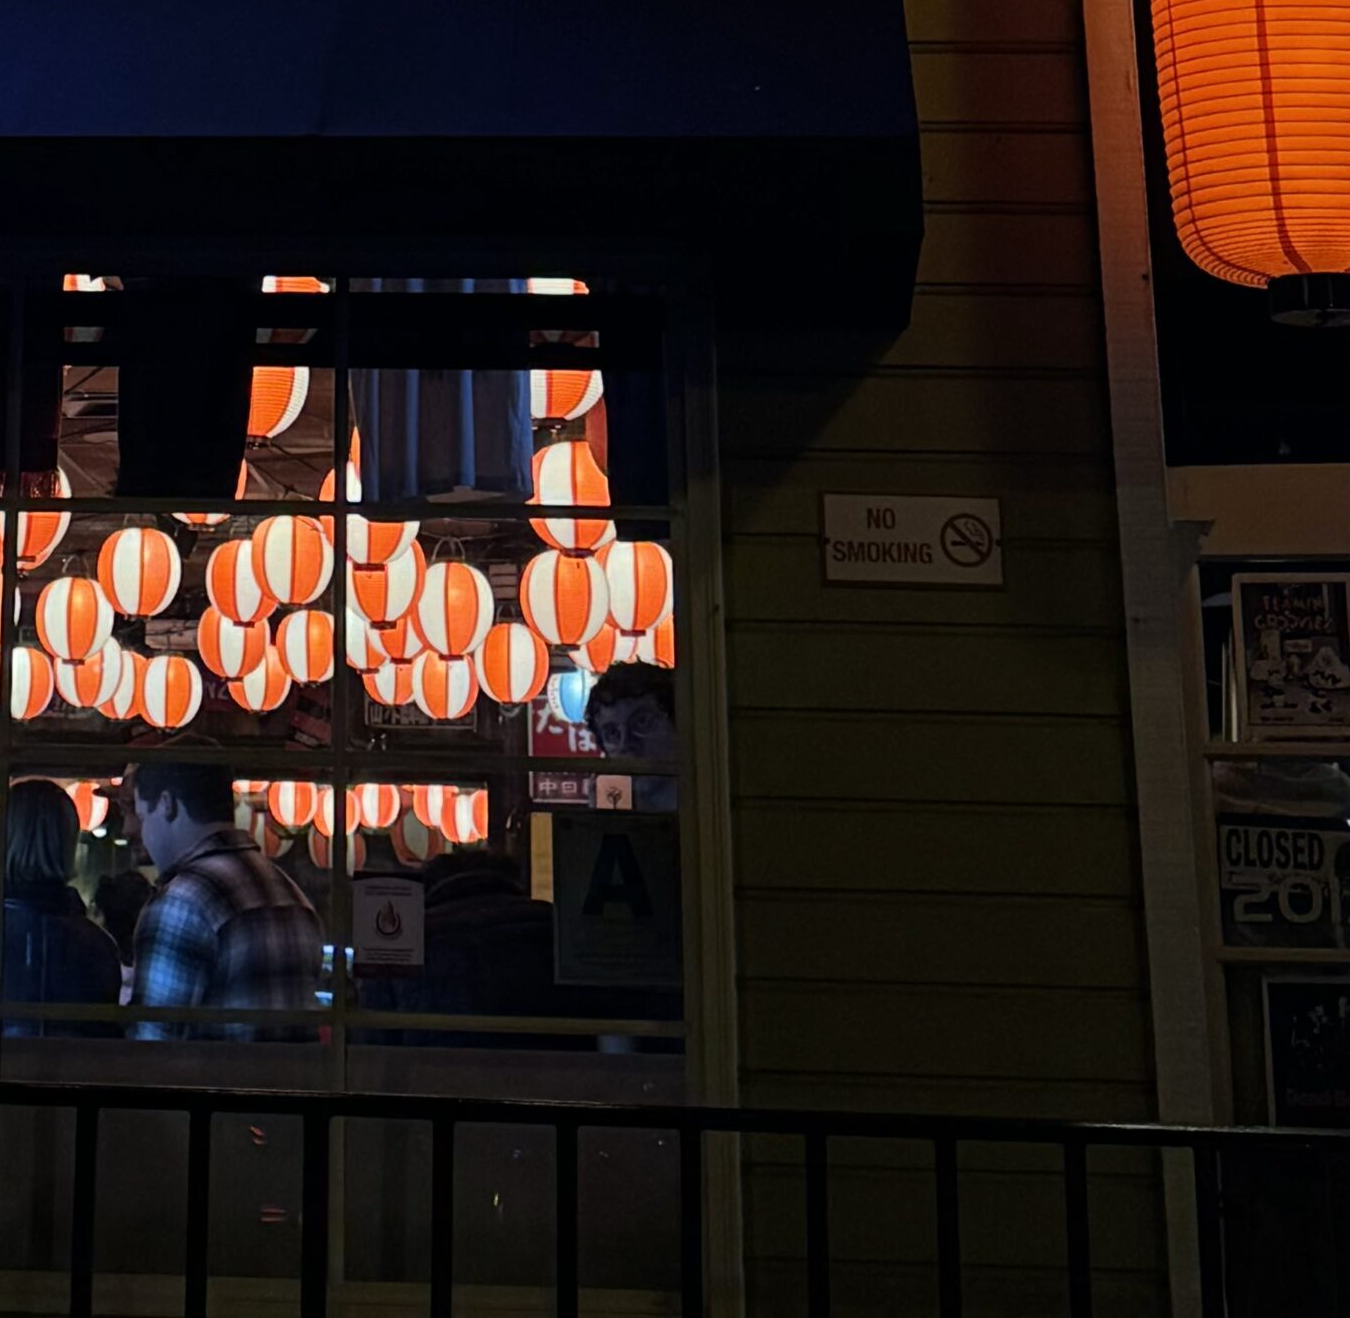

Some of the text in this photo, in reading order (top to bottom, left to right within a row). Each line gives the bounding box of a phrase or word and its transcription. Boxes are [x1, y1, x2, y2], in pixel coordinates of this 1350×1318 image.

[867, 507, 896, 529] NO
[832, 540, 934, 565] SMOKING
[538, 777, 590, 796] 中日
[1226, 829, 1324, 871] CLOSED
[582, 834, 653, 916] A
